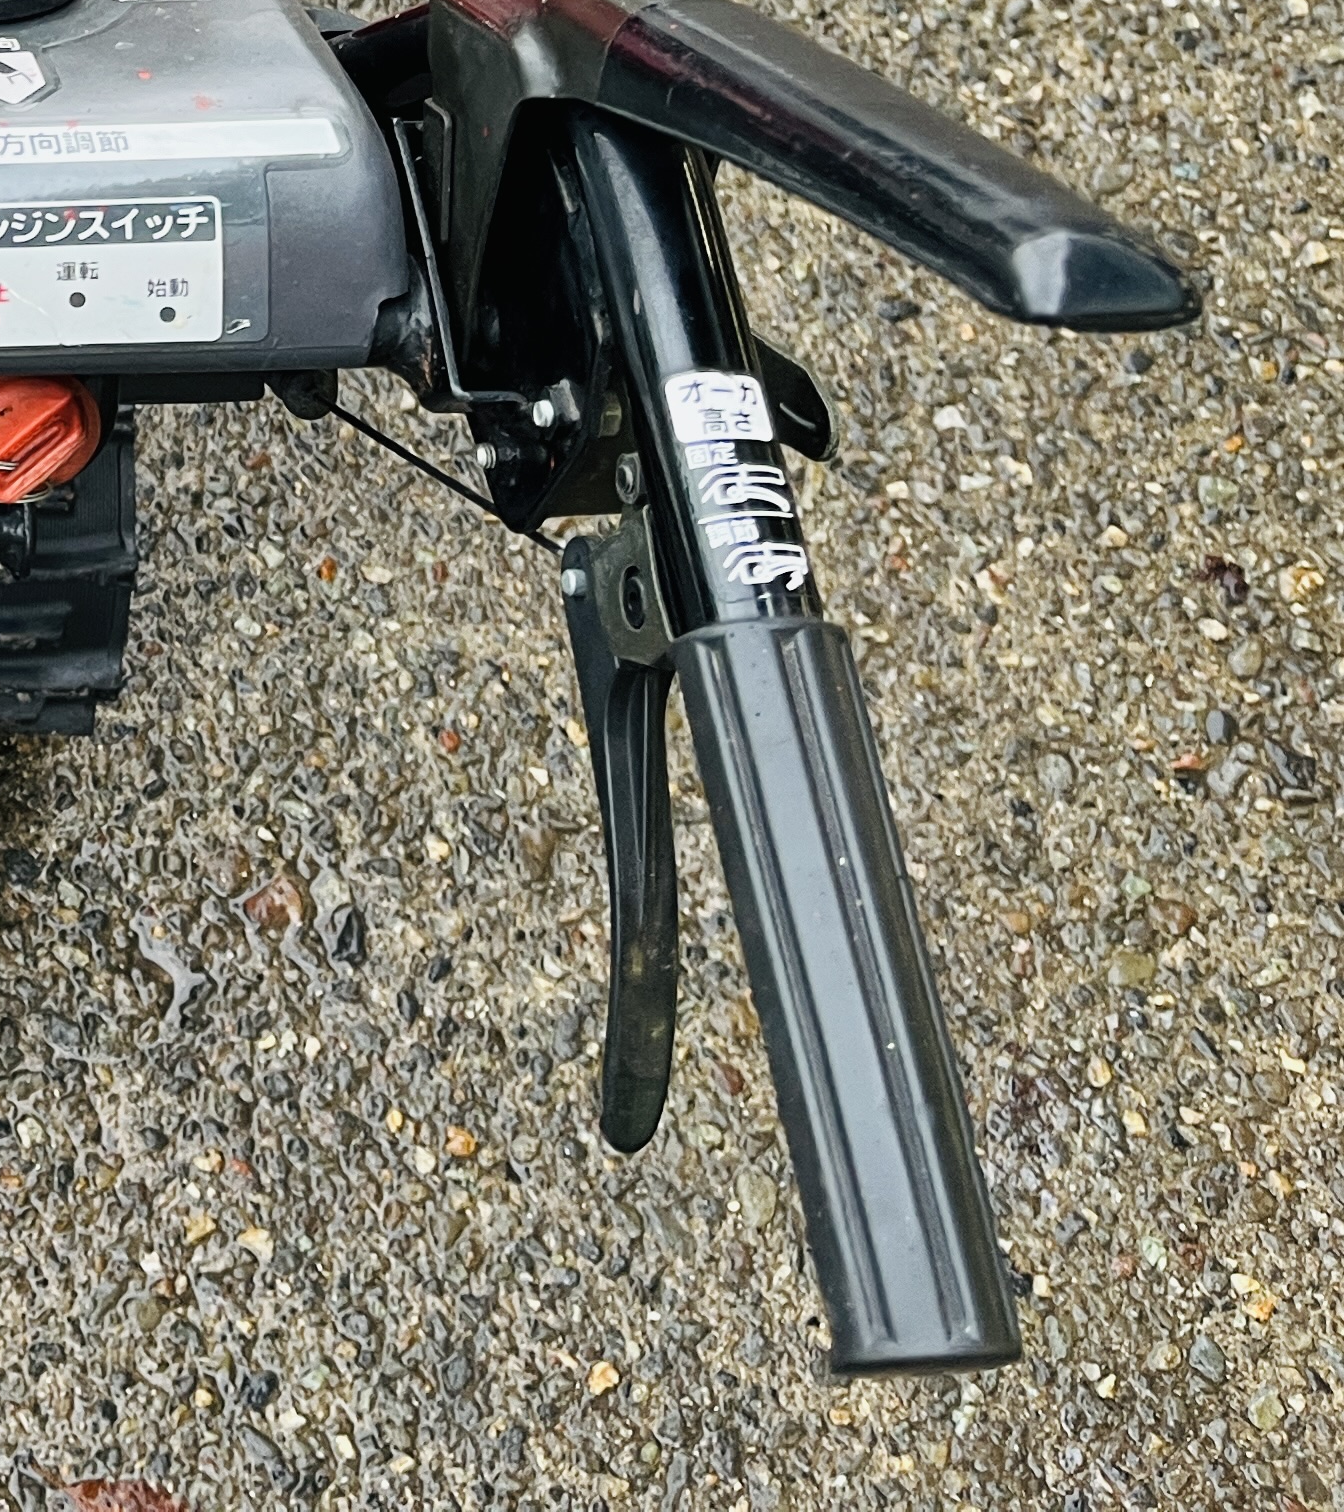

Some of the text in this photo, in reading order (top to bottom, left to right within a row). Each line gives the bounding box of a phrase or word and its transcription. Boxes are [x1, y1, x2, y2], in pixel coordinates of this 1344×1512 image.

[56, 261, 100, 281] 運転
[147, 277, 190, 298] 始動
[698, 408, 753, 435] 高さ
